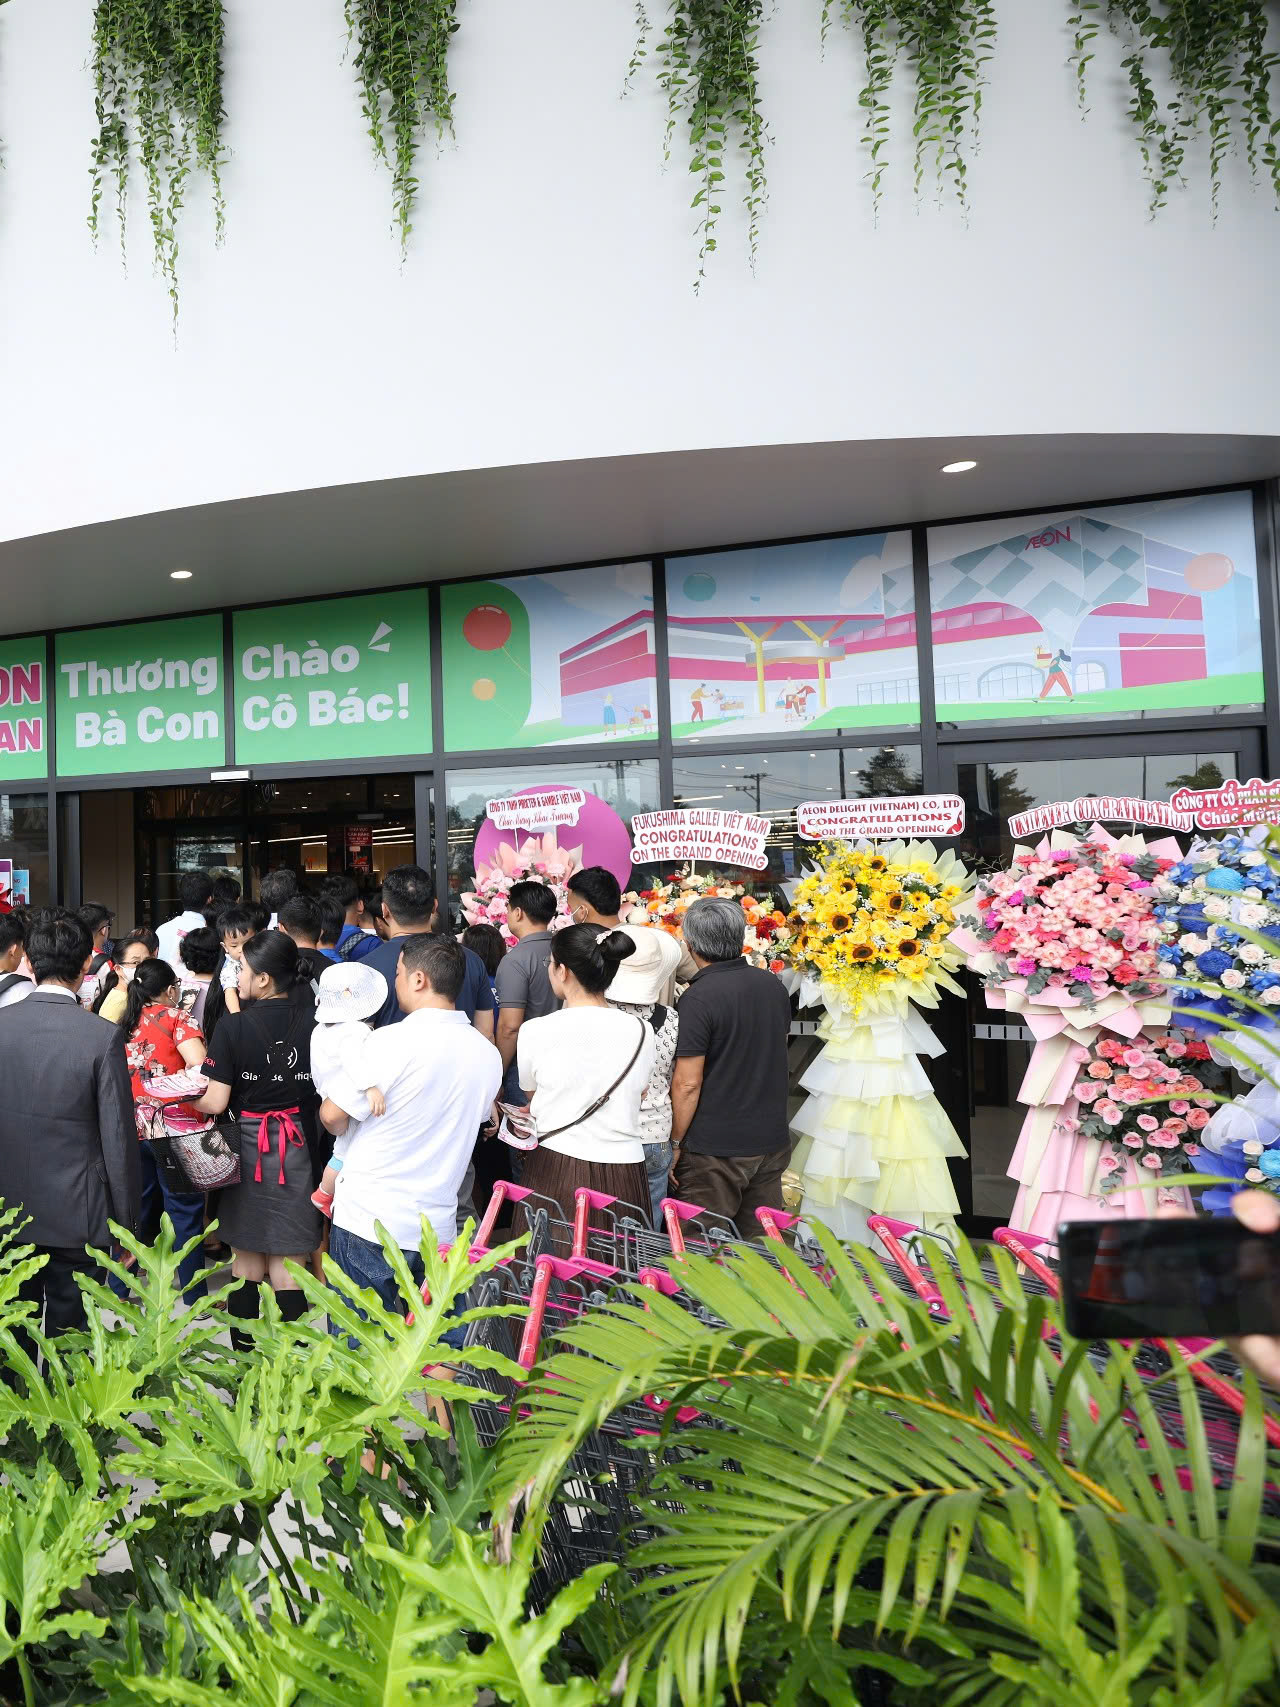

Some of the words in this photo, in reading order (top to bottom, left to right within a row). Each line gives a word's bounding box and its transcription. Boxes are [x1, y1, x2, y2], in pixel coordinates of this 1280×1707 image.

[242, 640, 360, 682] Chào
[61, 656, 218, 699] Thương
[242, 693, 295, 732] Cô
[308, 682, 410, 728] Bác!
[75, 709, 125, 748] Bà
[137, 704, 218, 743] Con
[802, 805, 827, 815] AEON
[829, 803, 867, 814] DELIGHT
[869, 801, 920, 814] (VIETNAM)
[943, 799, 960, 809] LTD
[1175, 792, 1204, 810] CÔNG
[1205, 793, 1219, 808] TY
[633, 810, 686, 831] FUKUSHIMA
[689, 810, 721, 826] GALILEI
[744, 816, 769, 836] NAM
[807, 812, 952, 826] CONGRATULATIONS
[821, 827, 837, 836] ON
[839, 826, 856, 835] THE
[859, 825, 894, 836] GRAND
[896, 824, 945, 834] OPENING
[1011, 803, 1070, 837] UNILEVER
[640, 829, 759, 851] CONGRATULATIONS
[632, 848, 649, 863] ON
[652, 846, 670, 859] THE
[673, 845, 712, 859] GRAND
[715, 847, 766, 869] OPENING
